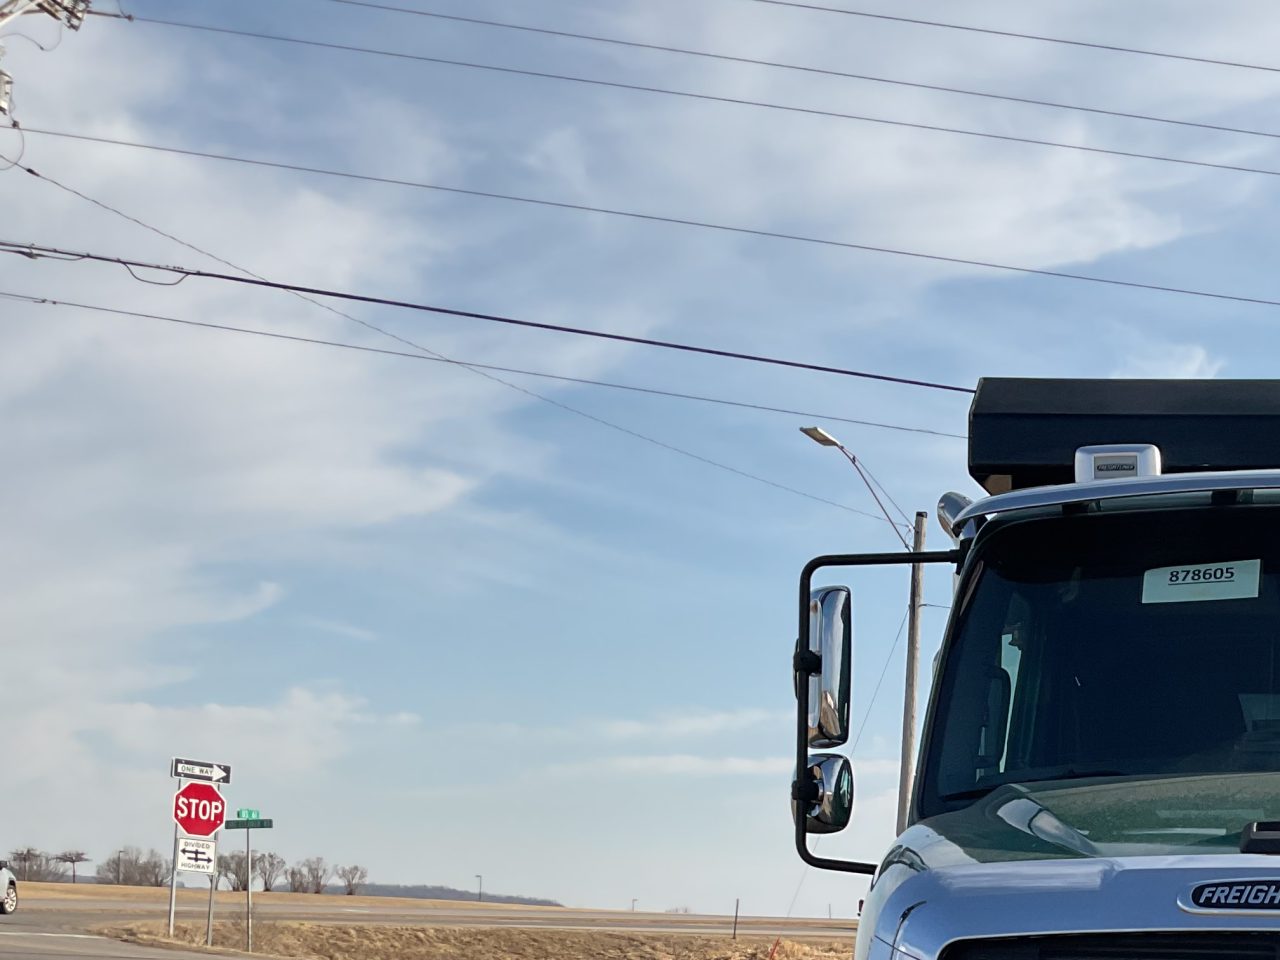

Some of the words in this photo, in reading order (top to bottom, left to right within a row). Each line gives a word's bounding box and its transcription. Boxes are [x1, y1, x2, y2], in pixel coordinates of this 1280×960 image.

[1169, 567, 1235, 583] 878605
[181, 765, 196, 773] ONE
[177, 797, 222, 821] STOP
[184, 841, 210, 849] DIVIDED
[181, 862, 210, 870] HIGHWAY
